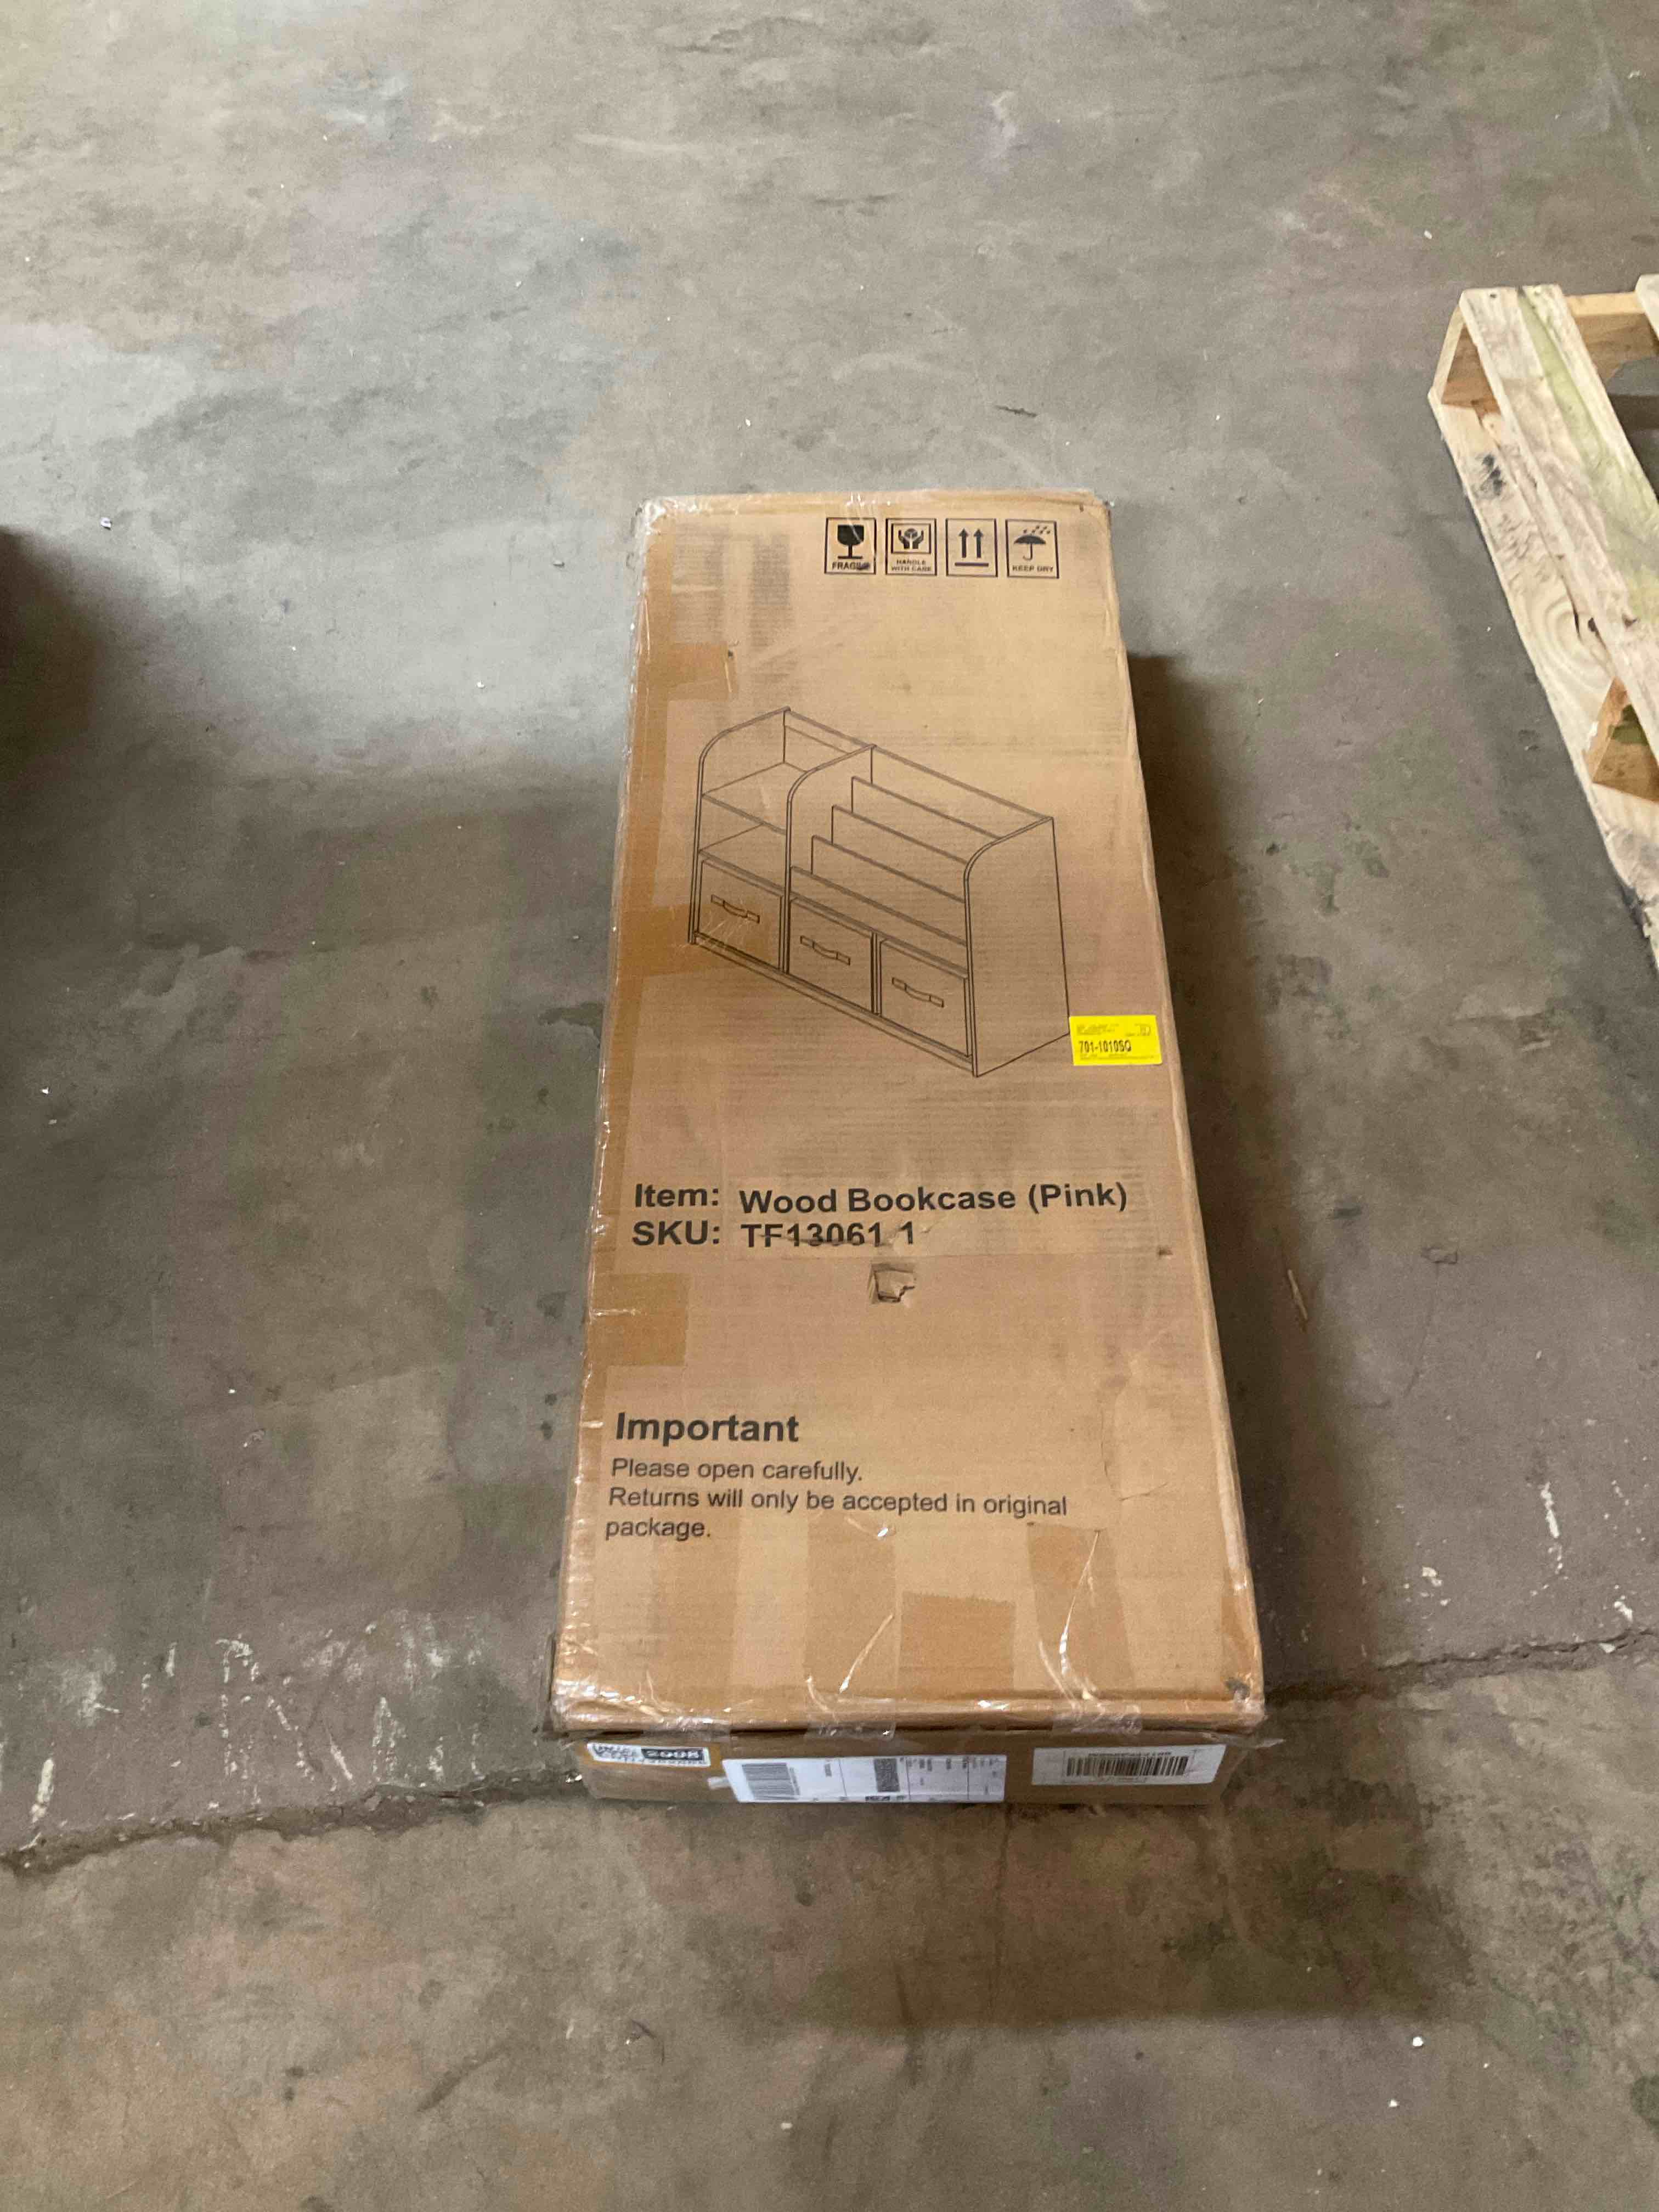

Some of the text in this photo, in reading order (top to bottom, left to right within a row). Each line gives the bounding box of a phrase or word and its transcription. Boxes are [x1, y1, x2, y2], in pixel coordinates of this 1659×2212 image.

[635, 1182, 1127, 1214] Item: Wood Bookcase (Pink)
[631, 1220, 720, 1246] SKU:
[616, 1412, 799, 1446] Important
[611, 1457, 862, 1485] Please open carefully.
[609, 1487, 1067, 1519] Returns will only be accepted in original
[606, 1517, 710, 1541] package.
